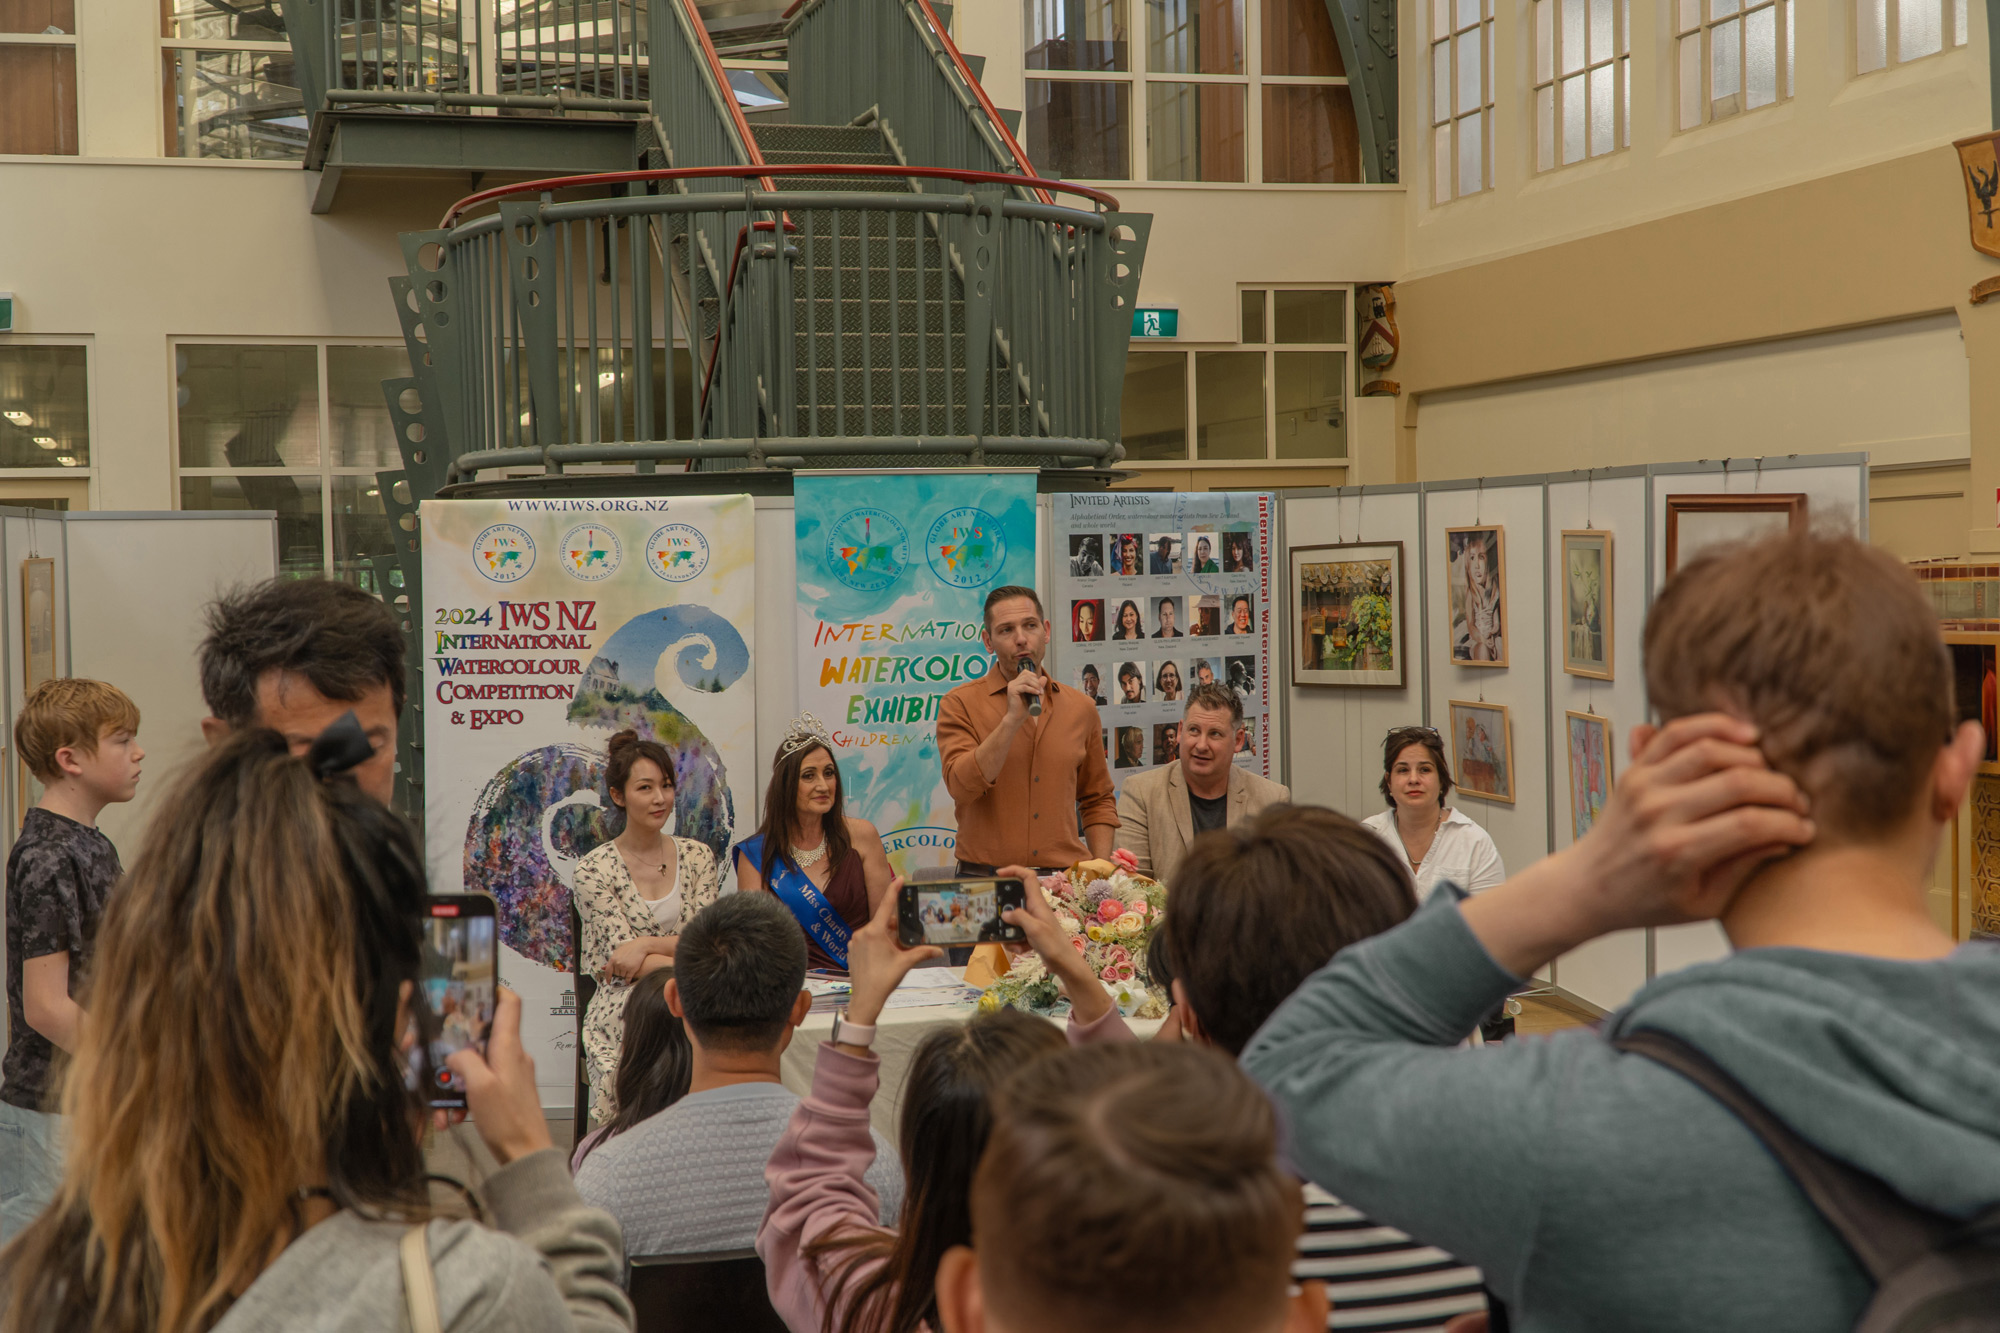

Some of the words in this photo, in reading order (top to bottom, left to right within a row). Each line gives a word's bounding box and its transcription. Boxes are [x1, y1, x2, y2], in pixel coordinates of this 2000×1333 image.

[508, 500, 669, 512] WWW.IWS.ORG.NZ
[1070, 494, 1110, 508] INVITED
[1113, 494, 1150, 508] ARTISTS
[930, 516, 950, 544] GLOBE
[950, 510, 967, 520] ART
[953, 526, 983, 539] IWS
[476, 532, 491, 550] GLOBE
[508, 526, 533, 550] NETWORK
[494, 538, 518, 547] IWS
[649, 531, 664, 550] GLOBE
[680, 526, 706, 550] NETWORK
[668, 538, 691, 546] IWS
[1258, 496, 1269, 603] International
[494, 572, 516, 580] 2012
[954, 574, 982, 584] 2012
[435, 606, 493, 627] 2024
[498, 601, 551, 631] IWS
[556, 601, 597, 631] NZ
[435, 630, 592, 654] INTERNATIONAL
[428, 658, 583, 677] WATERCOLOUR
[436, 680, 575, 704] COMPETITION
[450, 711, 466, 725] &
[470, 709, 524, 730] EXPO
[832, 730, 918, 748] CHILDREN
[798, 884, 820, 909] Miss
[818, 907, 850, 942] Charity
[810, 922, 821, 934] &
[821, 930, 848, 963] World
